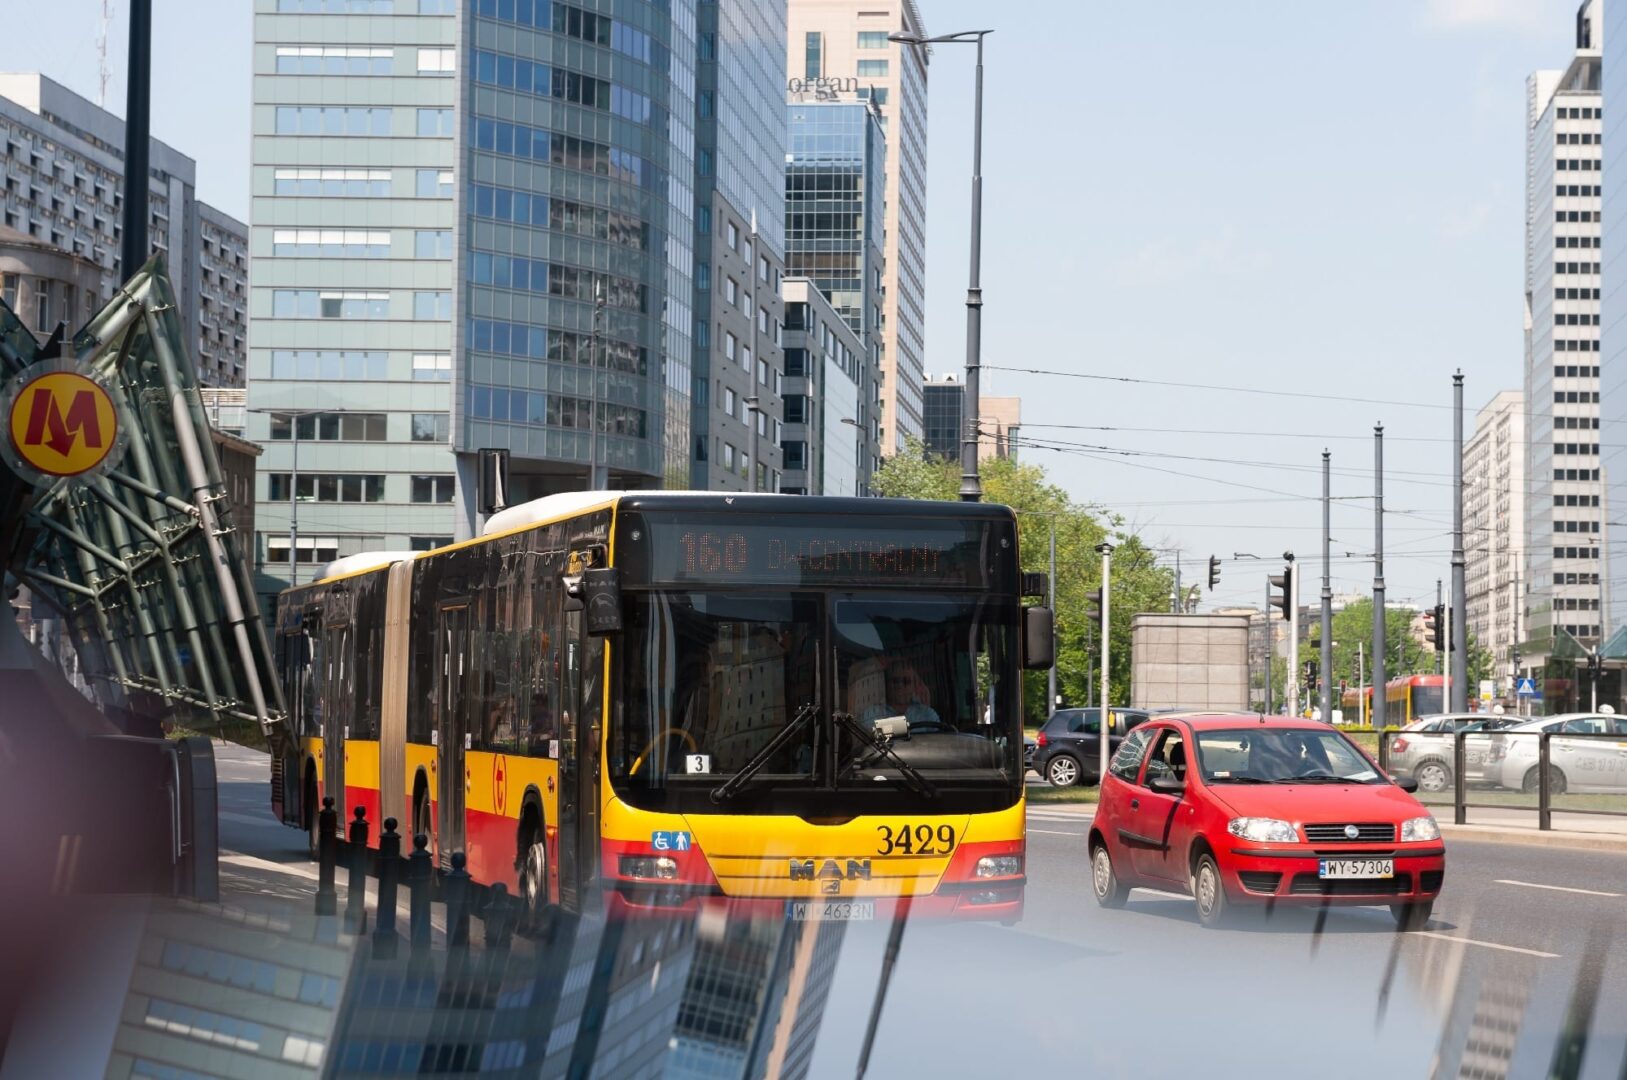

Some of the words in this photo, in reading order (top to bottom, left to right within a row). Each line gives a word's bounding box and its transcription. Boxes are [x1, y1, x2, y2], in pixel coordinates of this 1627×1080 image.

[786, 77, 858, 100] organ
[680, 531, 747, 573] 160
[695, 755, 703, 771] 3
[877, 825, 955, 855] 3429
[789, 858, 872, 881] MAN
[1328, 861, 1346, 875] WY
[1352, 861, 1391, 874] 57306
[823, 903, 872, 920] 4633N
